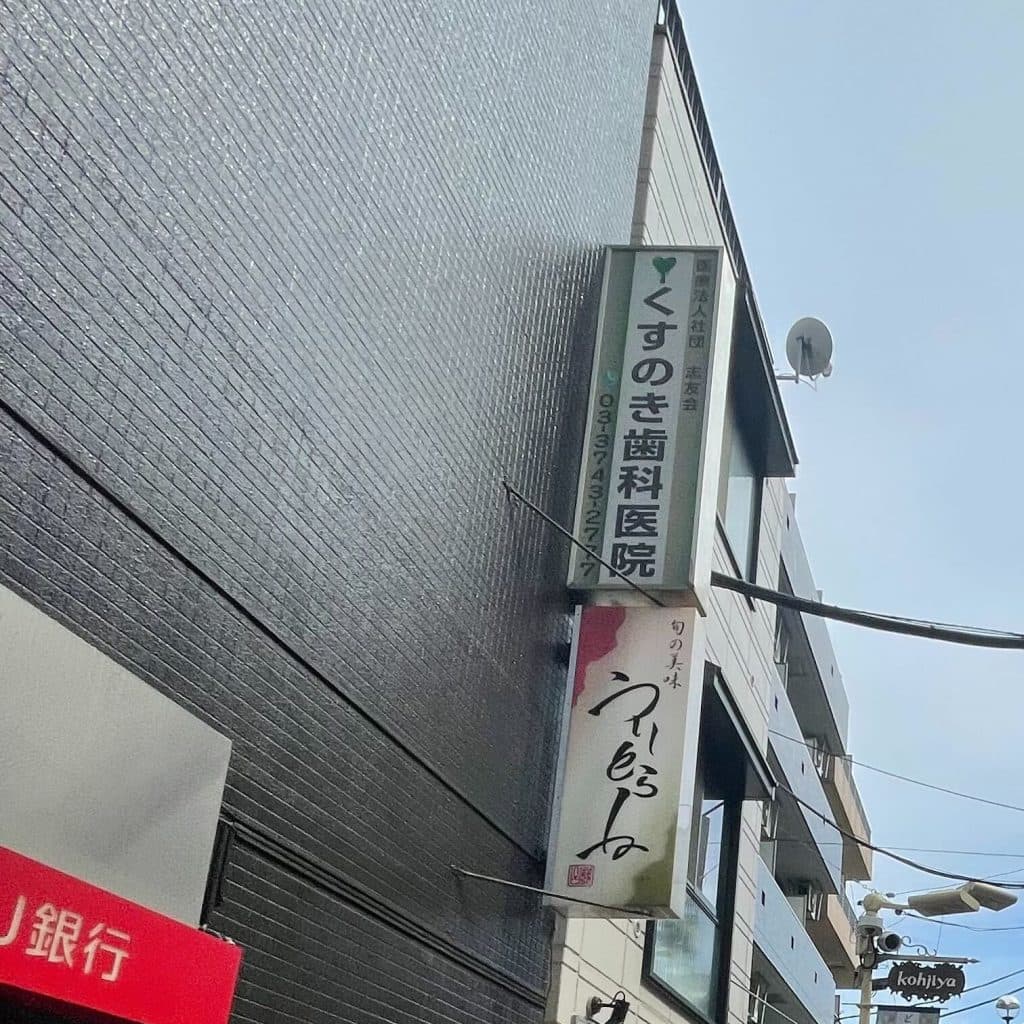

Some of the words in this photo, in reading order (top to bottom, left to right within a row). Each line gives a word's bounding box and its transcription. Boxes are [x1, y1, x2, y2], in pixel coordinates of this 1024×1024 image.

[609, 286, 678, 578] くすのき歯科医院
